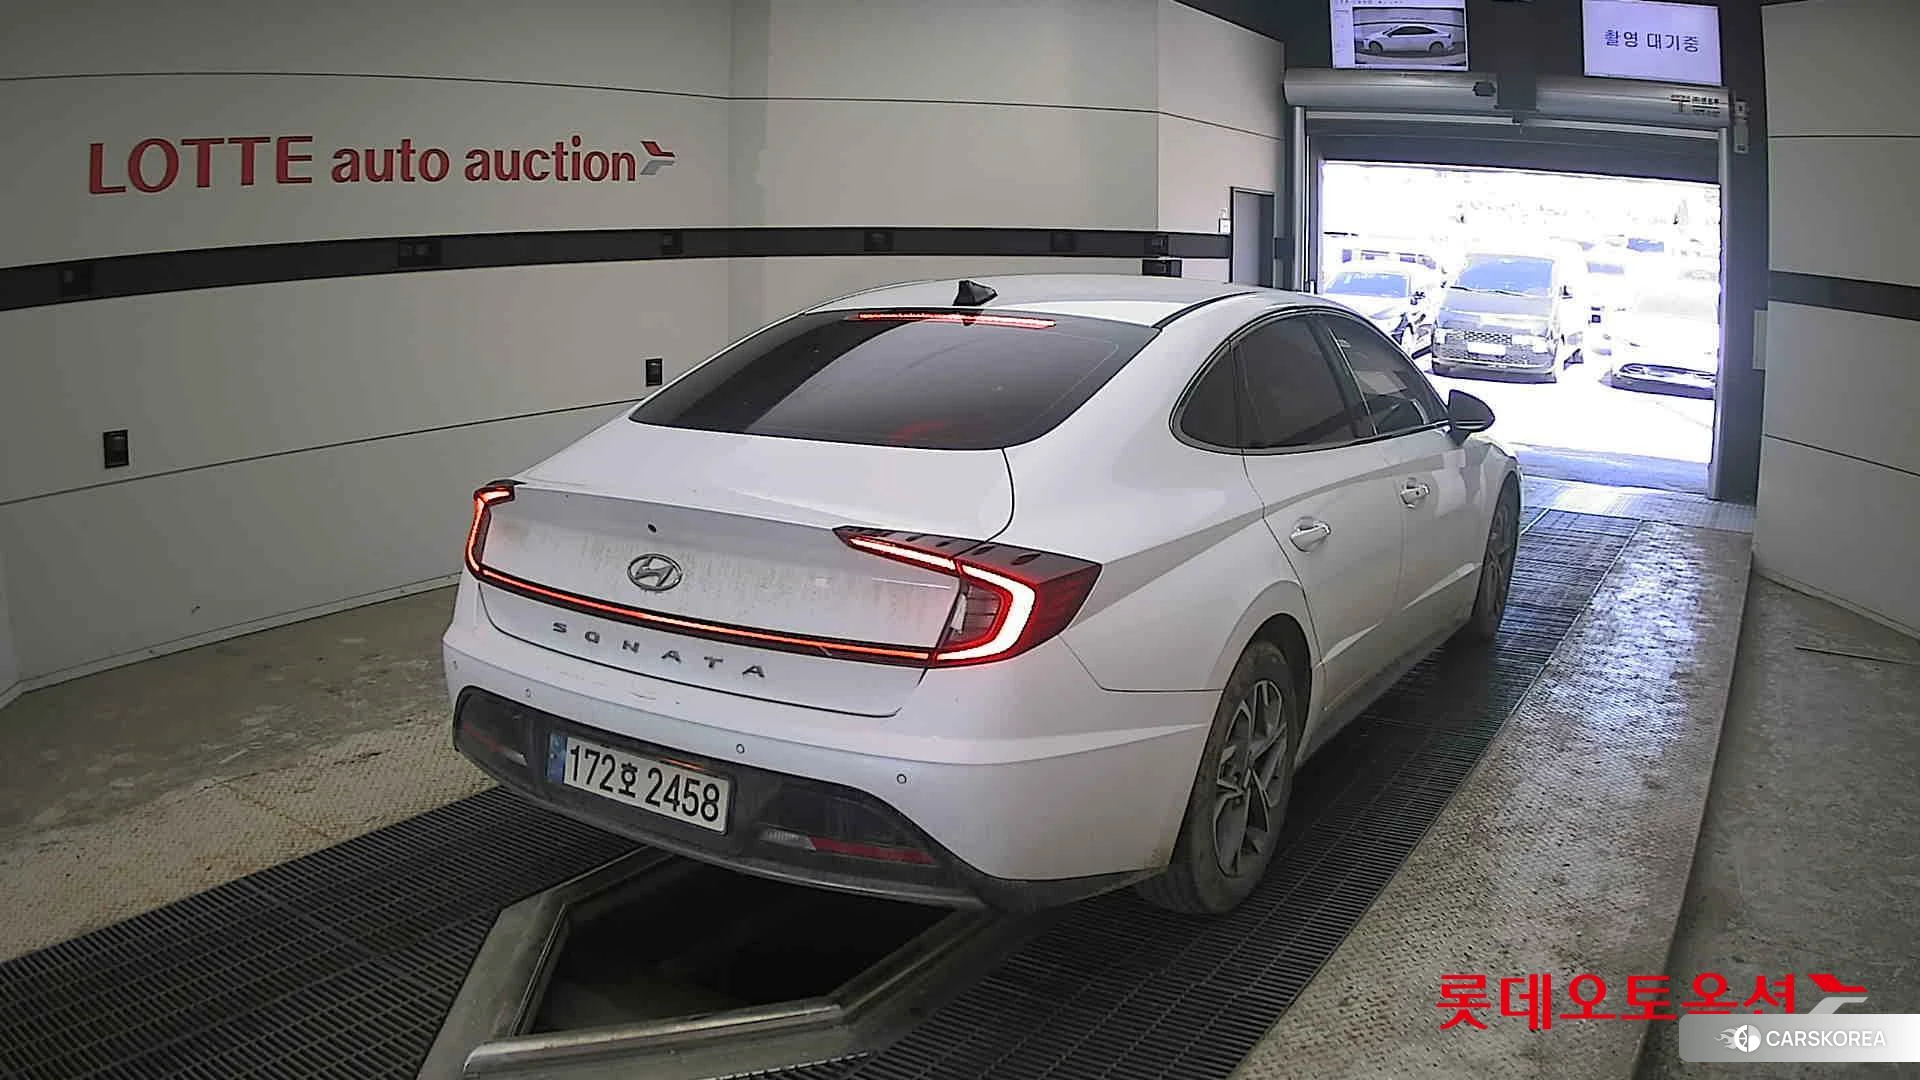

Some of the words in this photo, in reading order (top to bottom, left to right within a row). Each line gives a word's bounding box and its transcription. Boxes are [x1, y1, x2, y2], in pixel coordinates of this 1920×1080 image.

[1646, 32, 1699, 53] 대기중
[89, 135, 314, 195] LOTTE
[331, 138, 450, 184] auto
[464, 135, 637, 183] auction
[552, 621, 766, 679] SONATA
[570, 744, 638, 798] 172호
[645, 767, 720, 822] 2458
